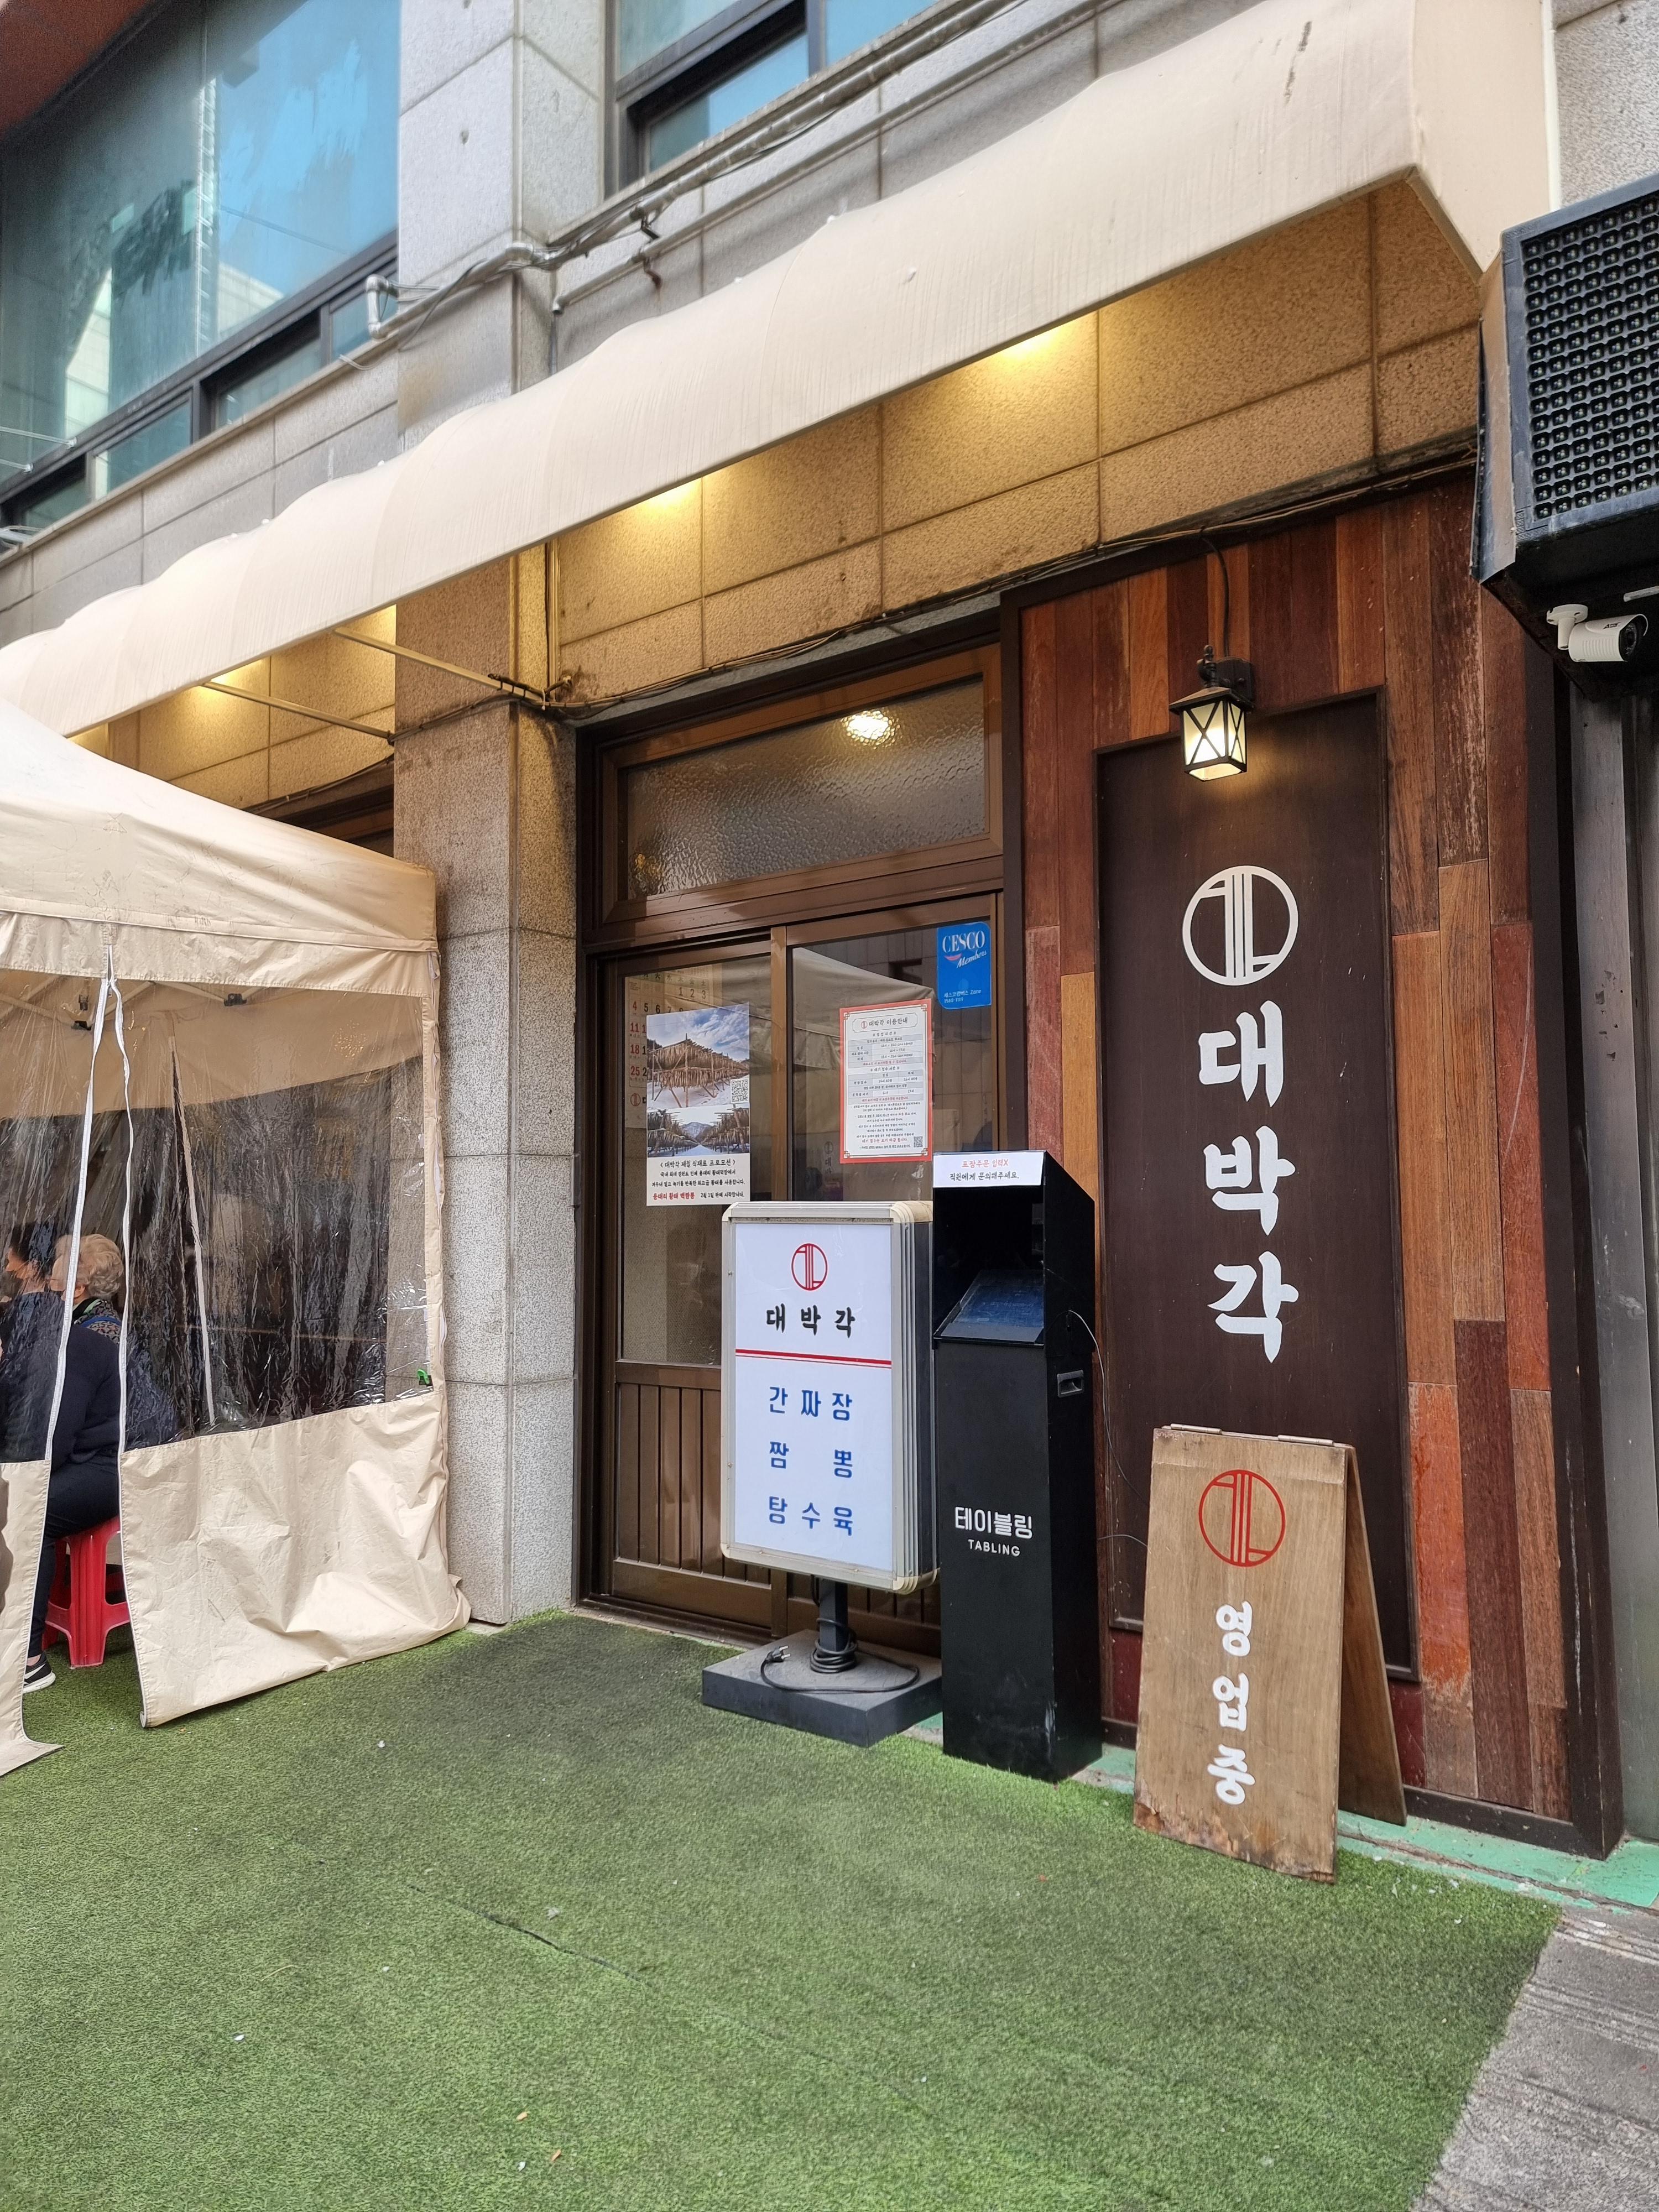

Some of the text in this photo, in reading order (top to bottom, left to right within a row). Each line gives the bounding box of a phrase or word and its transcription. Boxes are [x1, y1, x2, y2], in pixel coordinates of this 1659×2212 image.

[942, 930, 985, 953] CESCO
[956, 950, 987, 968] Members
[679, 987, 706, 999] 1 2 3
[633, 1001, 637, 1010] 4
[644, 1003, 649, 1013] 5
[655, 1004, 660, 1014] 6
[630, 1022, 639, 1032] 11
[886, 1016, 908, 1025] 이용안내
[630, 1044, 640, 1054] 18
[630, 1066, 640, 1076] 25
[692, 1159, 708, 1167] 식재료
[962, 1160, 990, 1168] 포장주문
[950, 1171, 1019, 1182] 직원에게 문의해주세요.
[1198, 1000, 1300, 1364] 대박각
[653, 1192, 667, 1201] 용대리
[766, 1302, 856, 1338] 대박각
[769, 1386, 853, 1421] 간짜장
[769, 1496, 853, 1536] 탕수육
[954, 1506, 1034, 1540] 테이블링
[968, 1538, 1021, 1557] TABLING
[1207, 1600, 1256, 1806] 영업중
